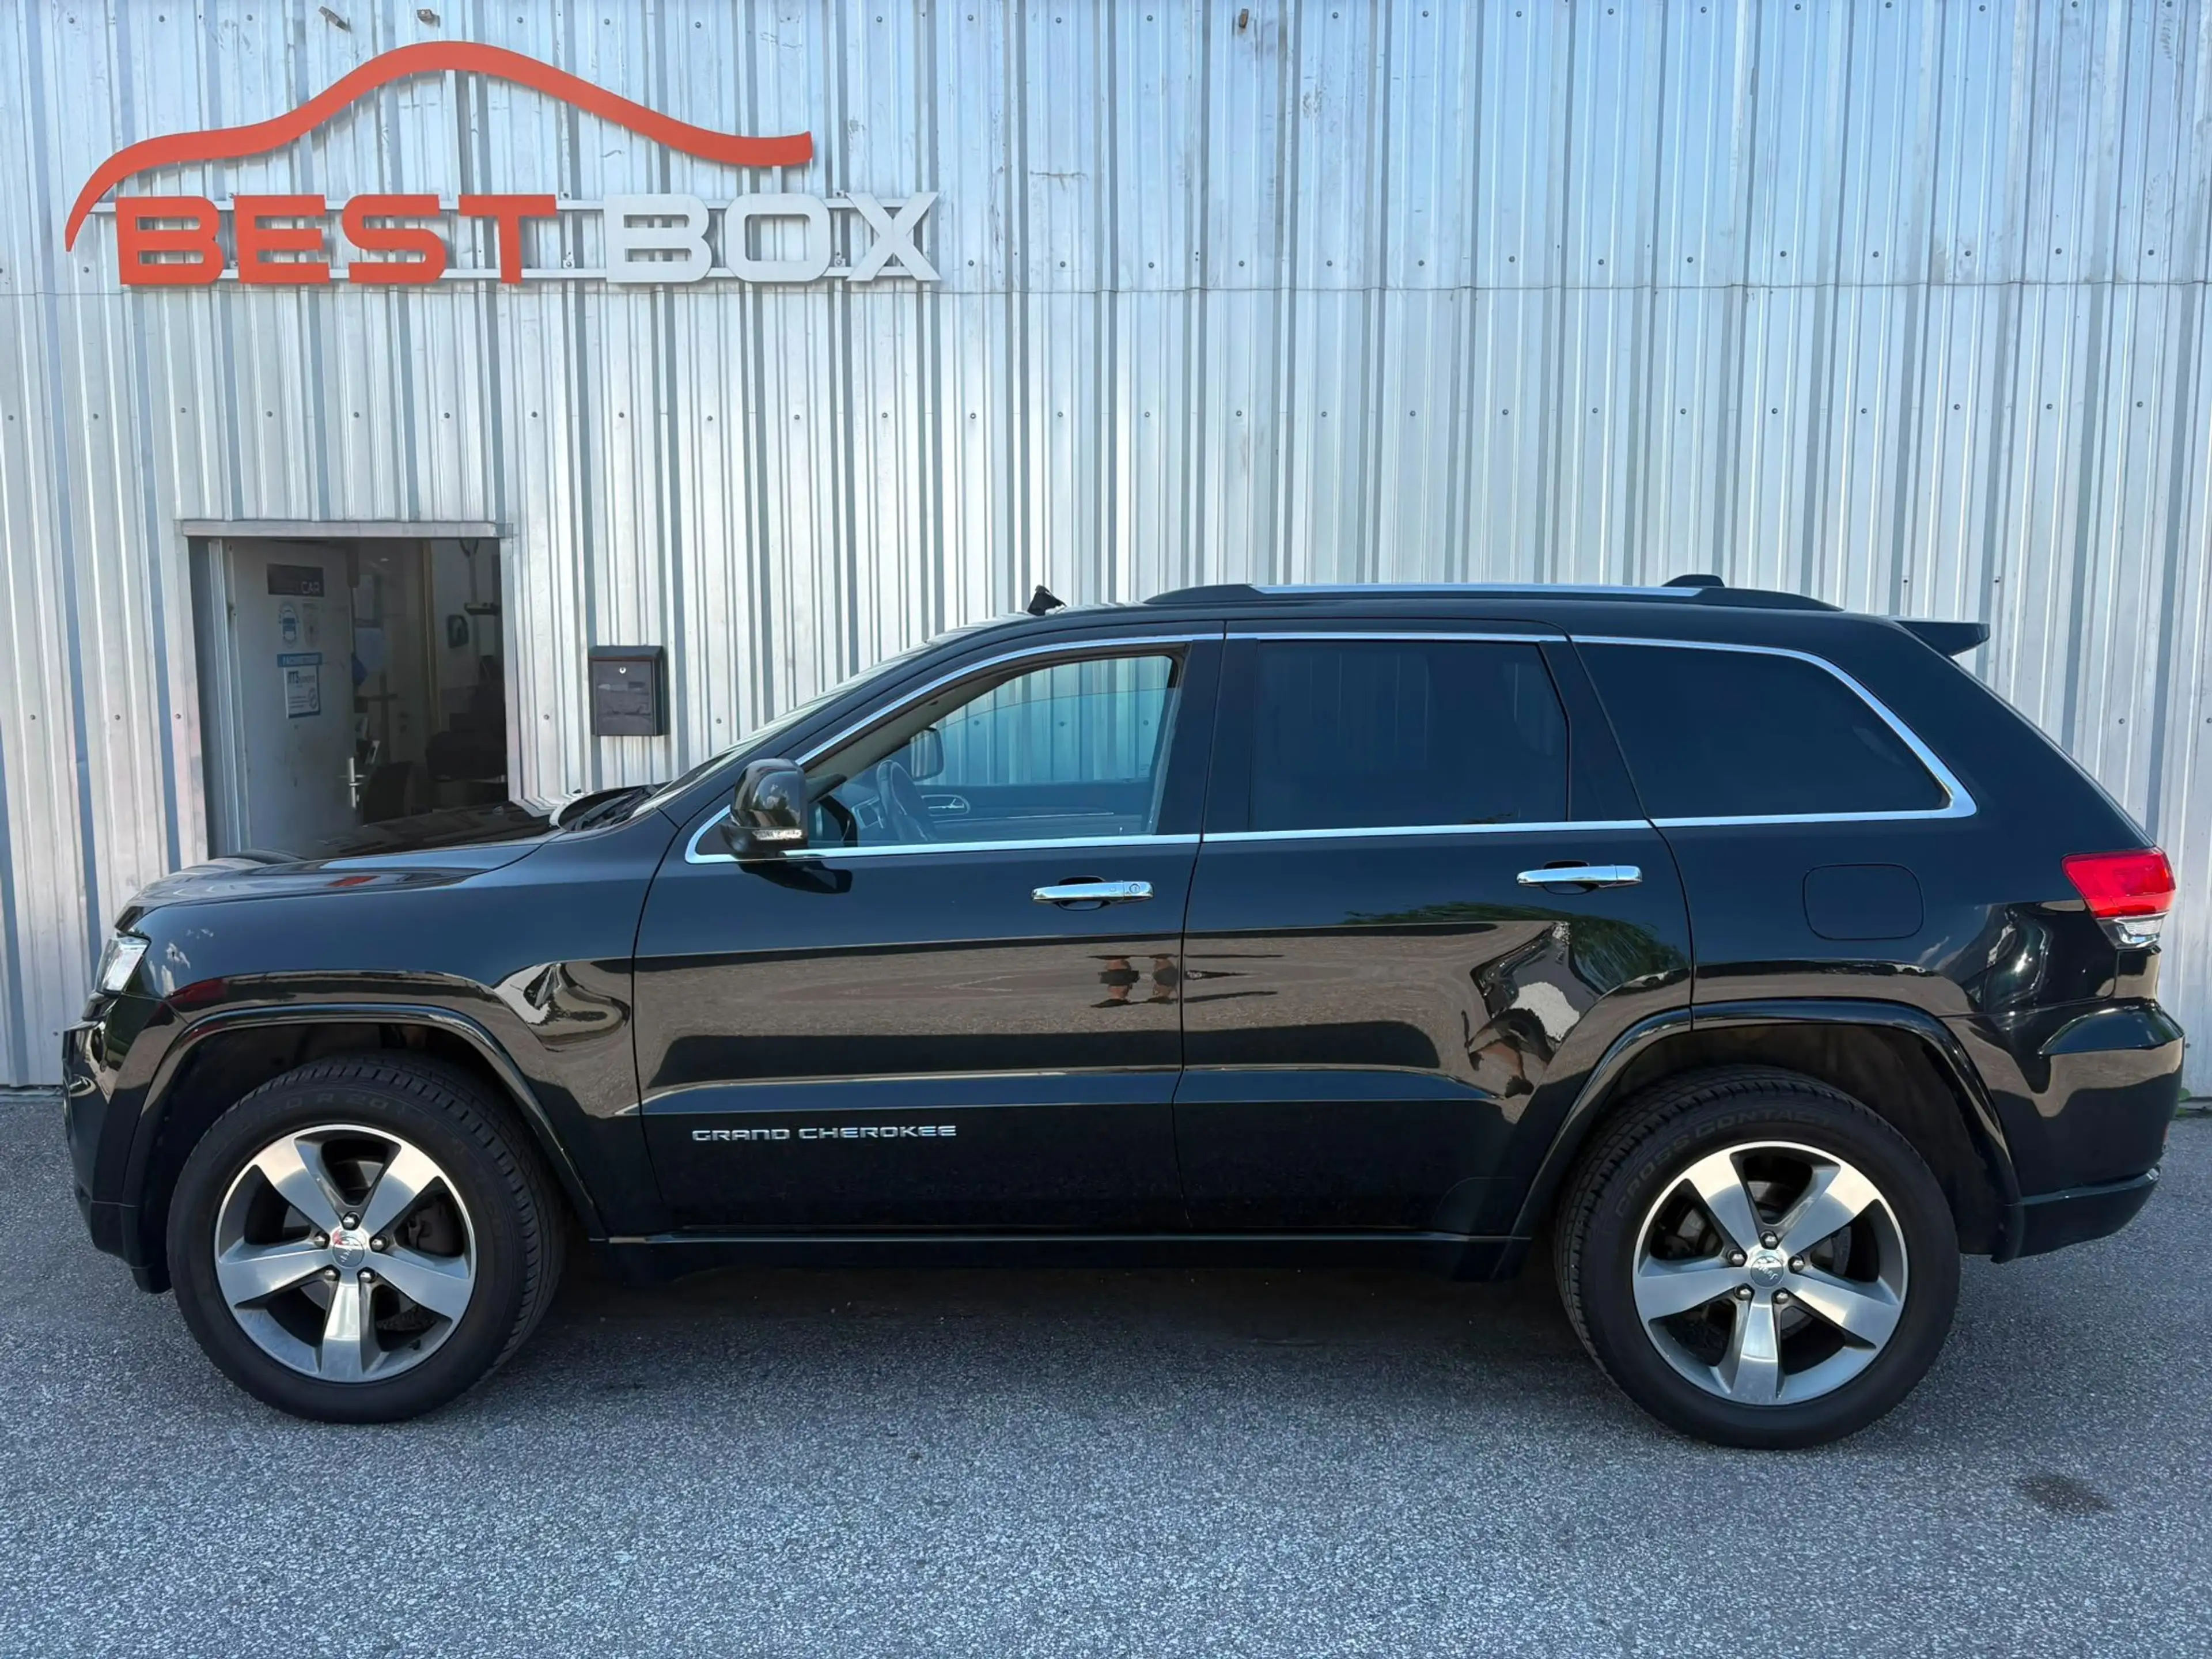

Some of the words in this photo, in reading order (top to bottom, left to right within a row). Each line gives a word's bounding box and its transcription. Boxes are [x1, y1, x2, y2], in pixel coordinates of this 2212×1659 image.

[115, 194, 557, 285] BEST
[603, 191, 941, 283] BOX
[692, 1128, 790, 1141] GRAND
[798, 1125, 957, 1139] CHEROKEE
